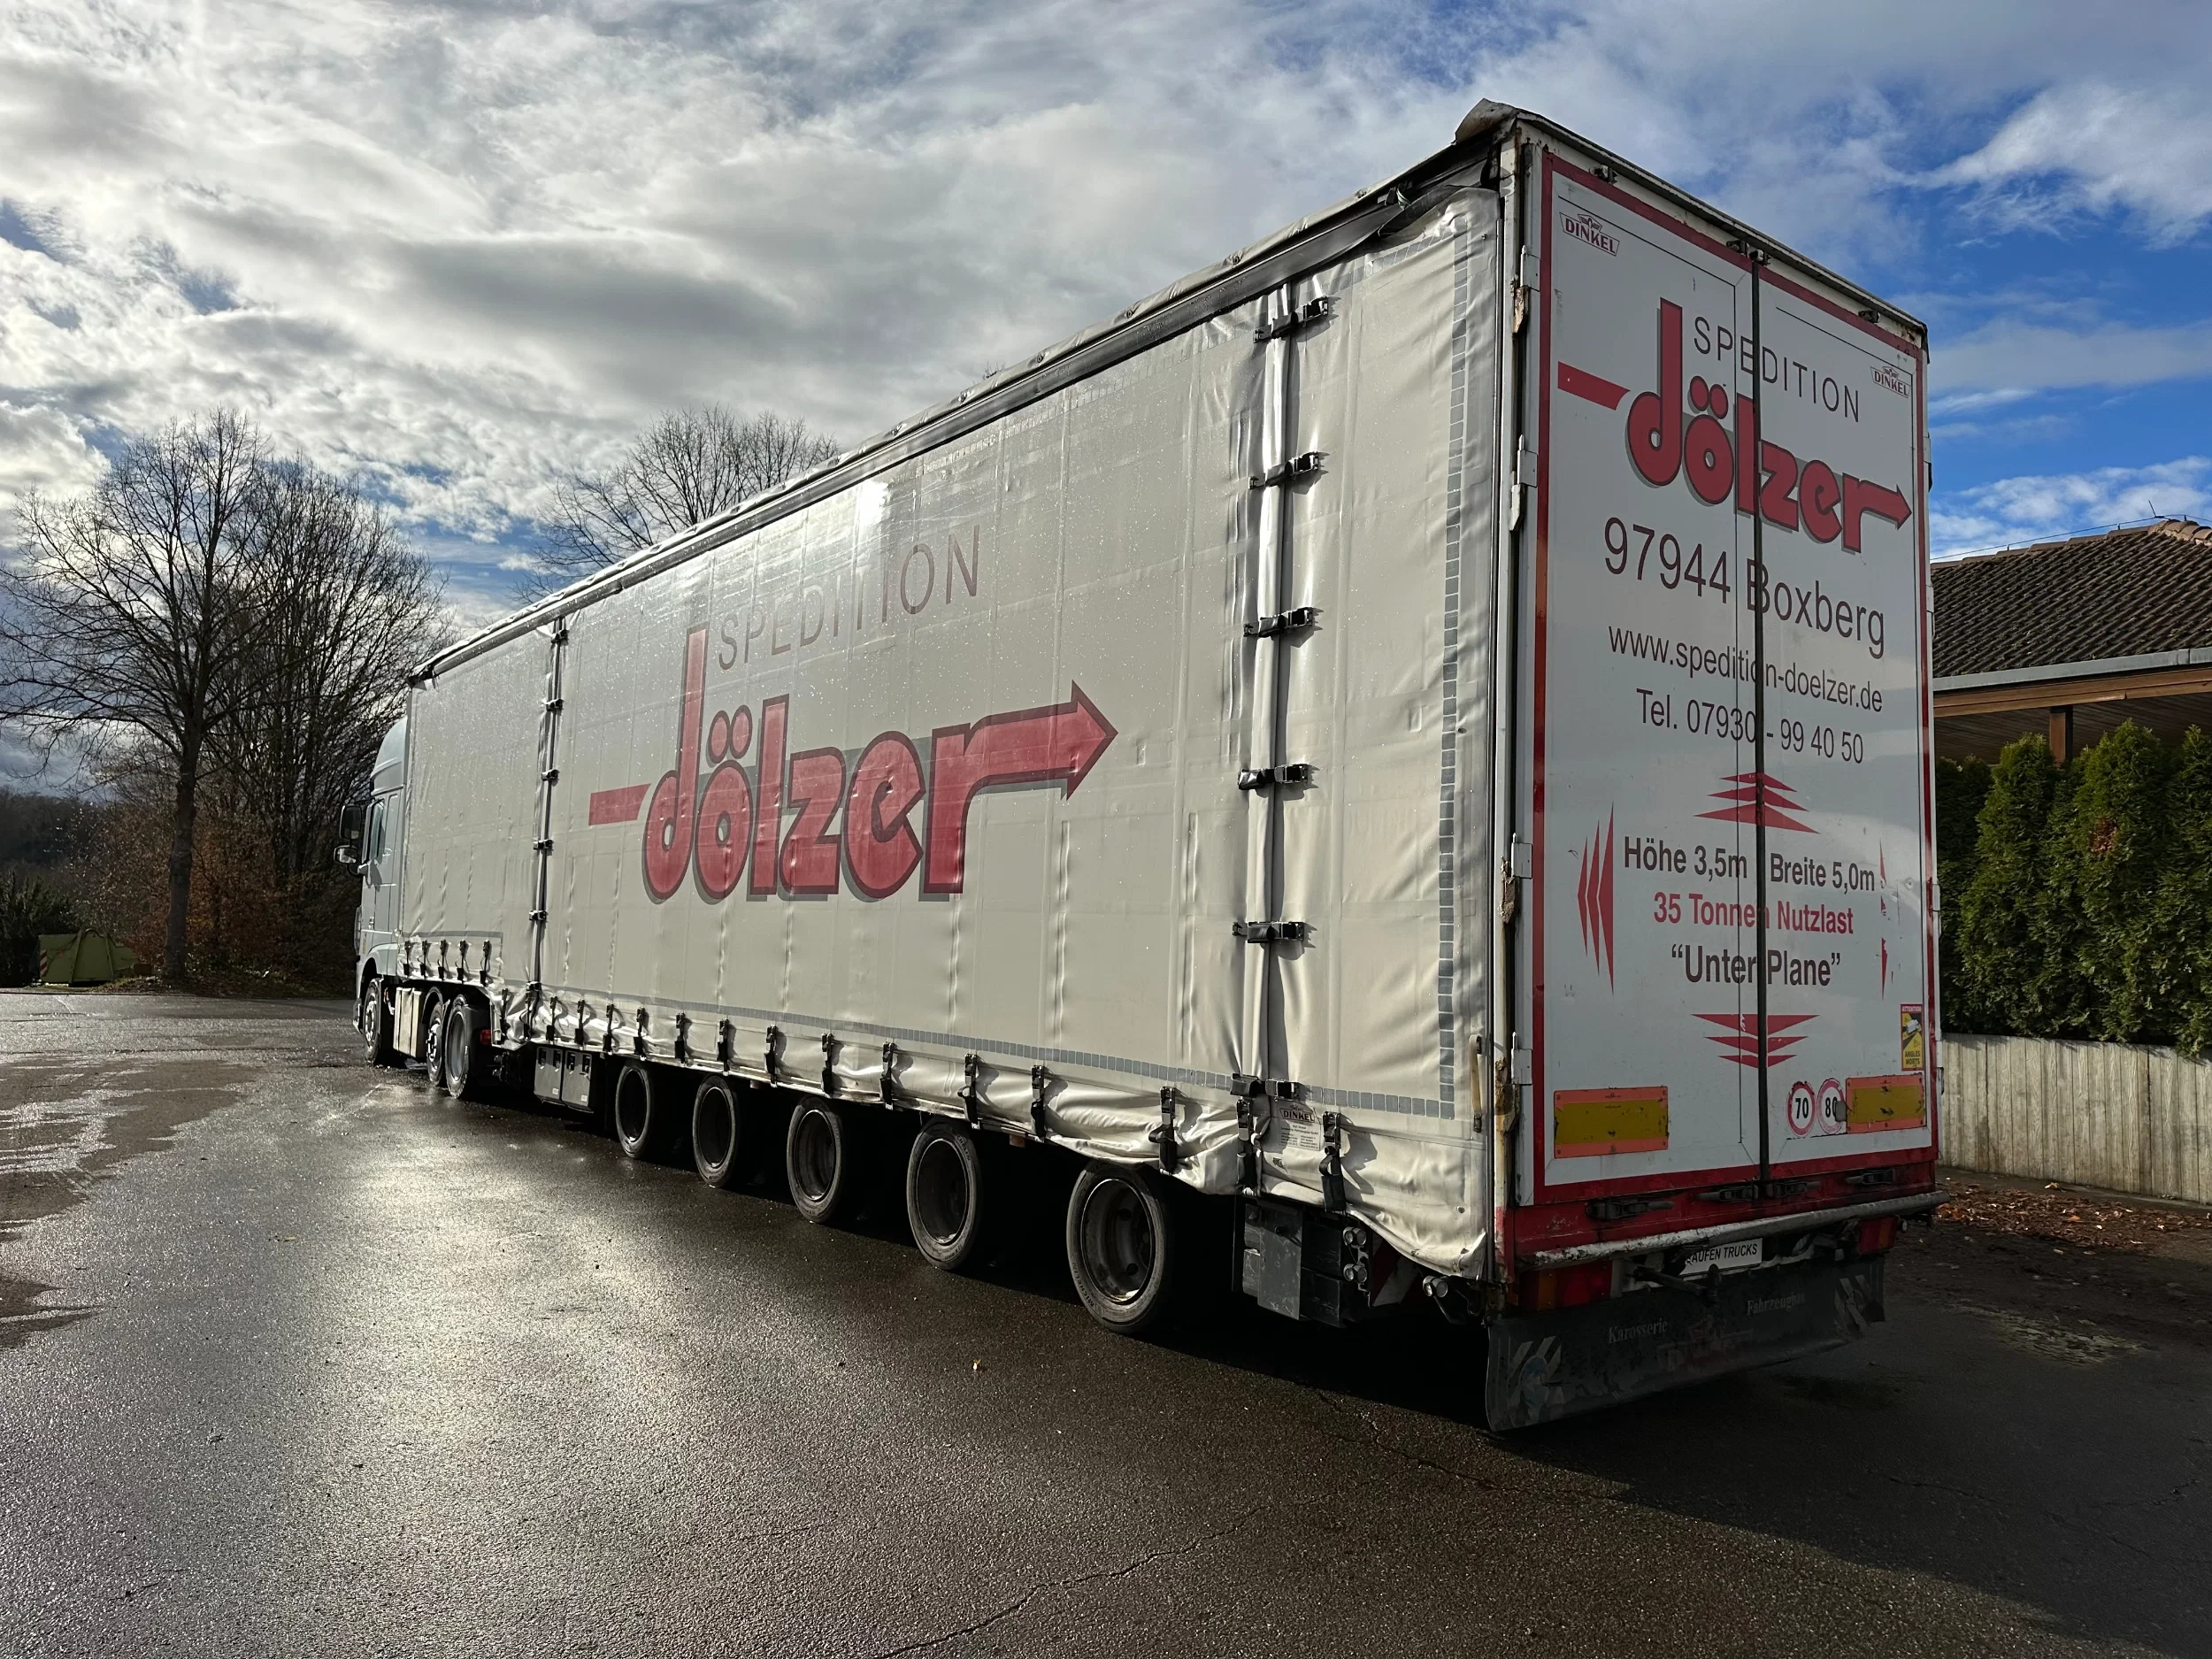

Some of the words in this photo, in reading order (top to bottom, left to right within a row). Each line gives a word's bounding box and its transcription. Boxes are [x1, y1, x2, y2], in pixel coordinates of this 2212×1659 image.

[1564, 219, 1617, 254] DINKEL
[1693, 316, 1860, 423] SPEDITION
[1873, 371, 1909, 396] DINKEL
[1626, 297, 1913, 554] dölzer
[718, 524, 980, 671] SPEDITION
[1603, 516, 1731, 604] 97944
[1746, 557, 1886, 659] Boxberg
[1636, 687, 1678, 730] Tel.
[1686, 699, 1756, 743] 07930
[1779, 718, 1805, 752] 99
[1810, 725, 1835, 758] 40
[1840, 730, 1864, 764] 50
[641, 625, 1119, 905] dölzer
[1624, 835, 1687, 874] Höhe
[1694, 843, 1747, 882] 3,5m
[1770, 851, 1827, 888] Breite
[1832, 862, 1876, 895] 5,0m
[1653, 891, 1682, 925] 35
[1688, 893, 1770, 930] Tonnen
[1777, 900, 1855, 935] Nutzlast
[1283, 1110, 1315, 1122] DINKEL
[1795, 1097, 1809, 1119] 70
[1724, 1243, 1758, 1259] TRUCKS
[1071, 1262, 1095, 1308] MICHELIN
[1608, 1317, 1669, 1345] Karosserie
[1746, 1291, 1806, 1317] Fahrzeugbau
